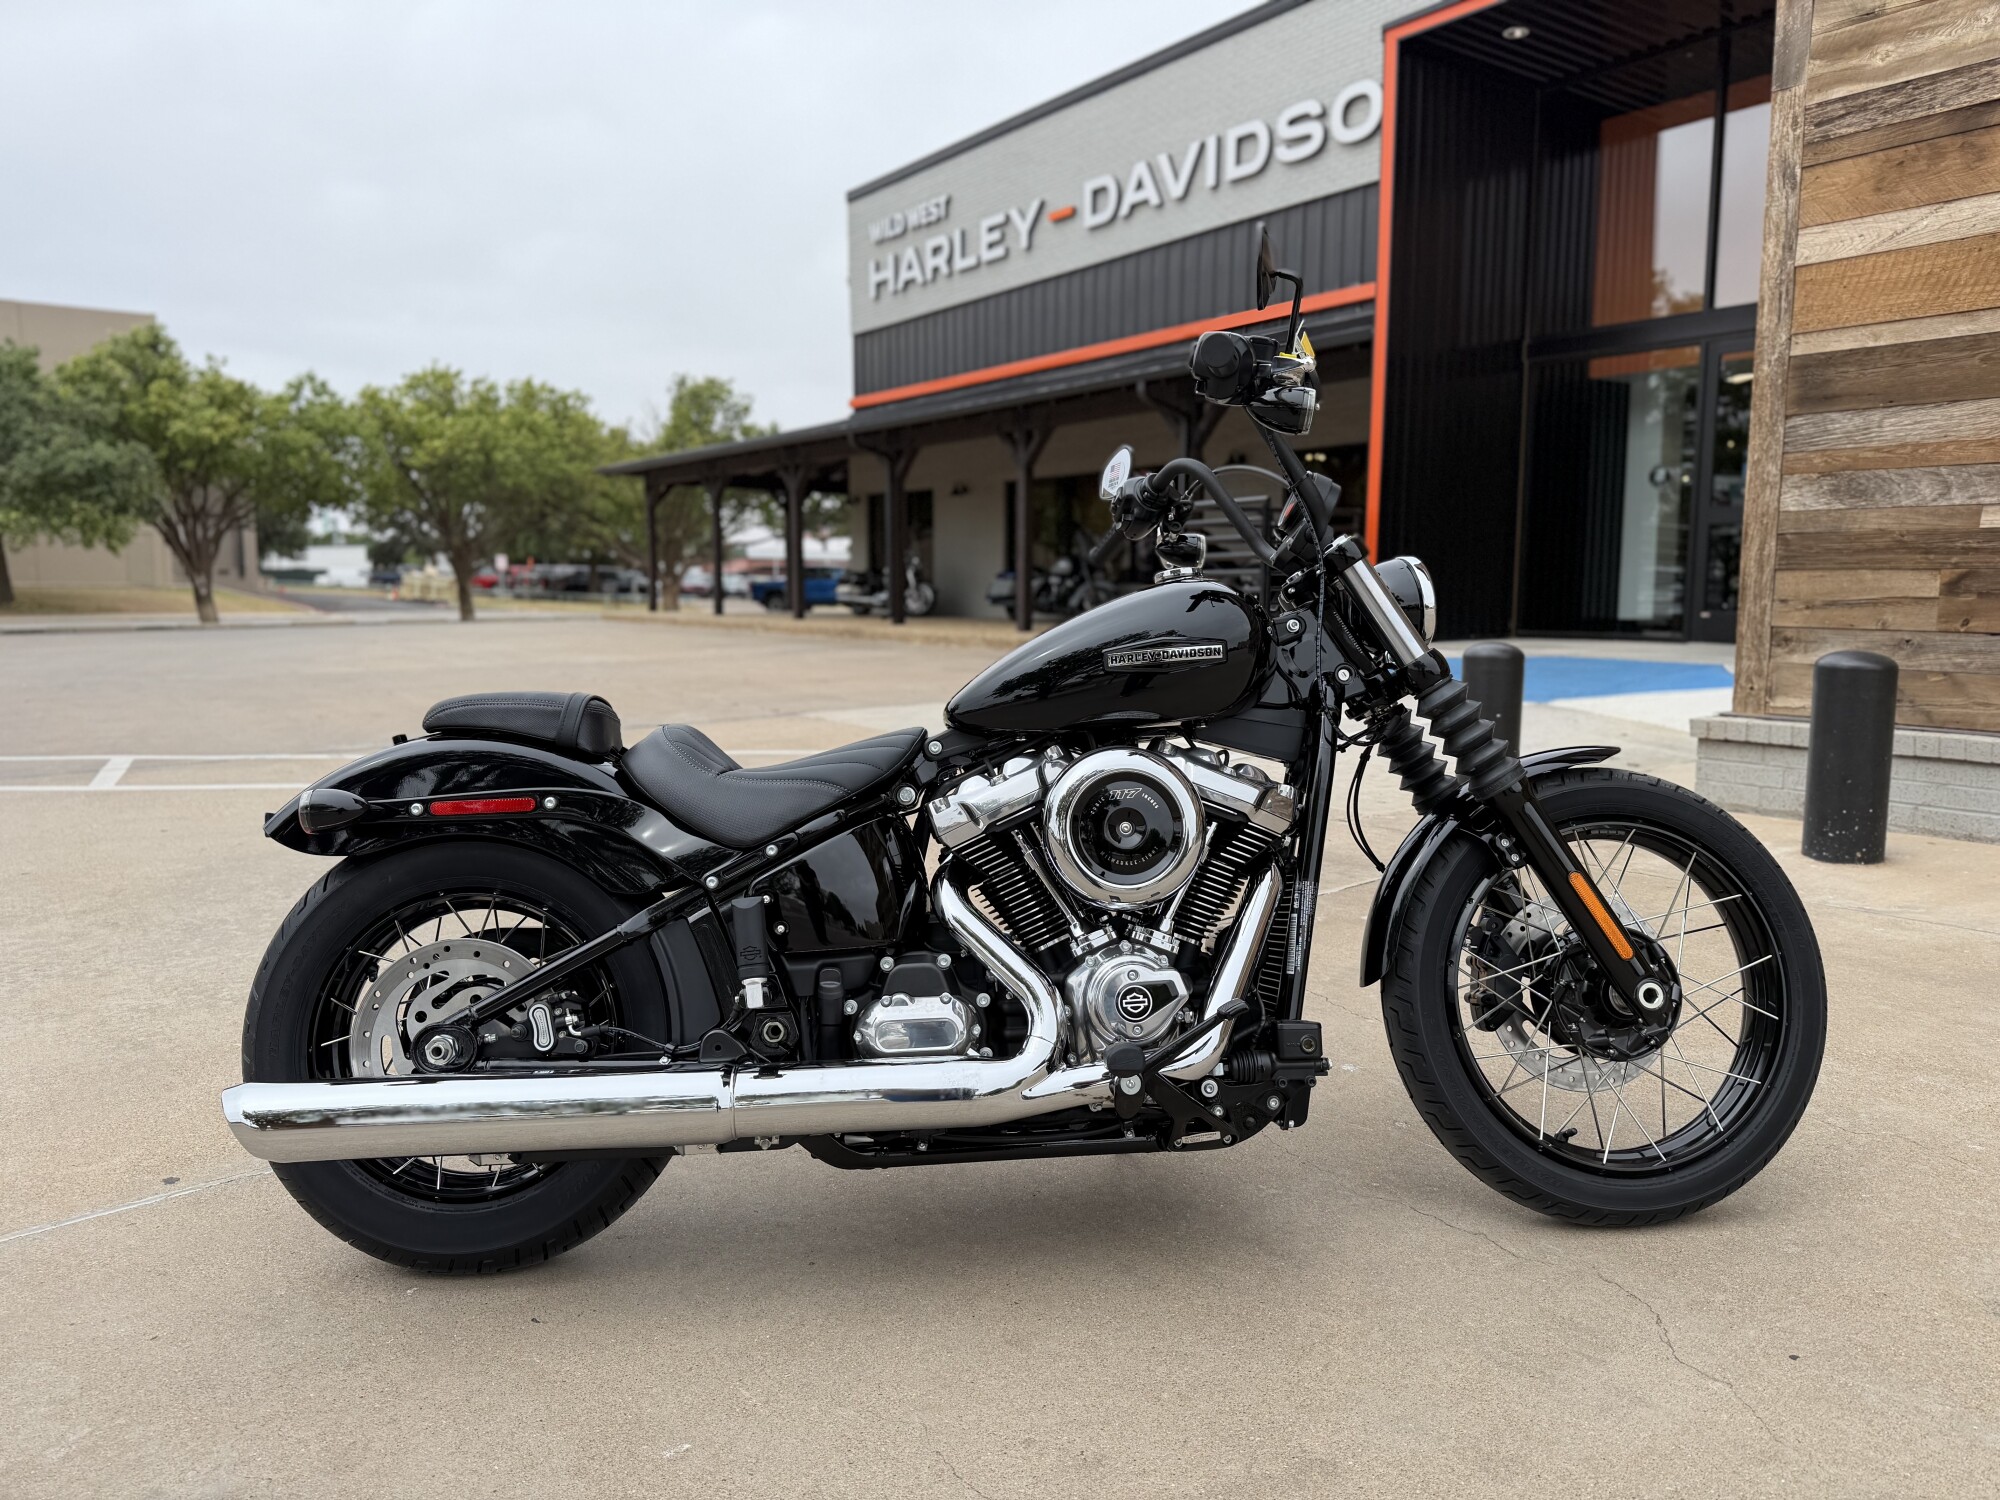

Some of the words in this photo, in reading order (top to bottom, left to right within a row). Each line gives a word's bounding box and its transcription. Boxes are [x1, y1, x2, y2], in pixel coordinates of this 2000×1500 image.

[868, 212, 906, 242] WILD
[905, 194, 950, 231] WEST
[1110, 647, 1222, 665] HARLEY-DAVIDSON
[1109, 787, 1143, 801] 117
[1141, 792, 1160, 809] INCHES
[1100, 846, 1159, 866] MILWAUKEE-EIGHT
